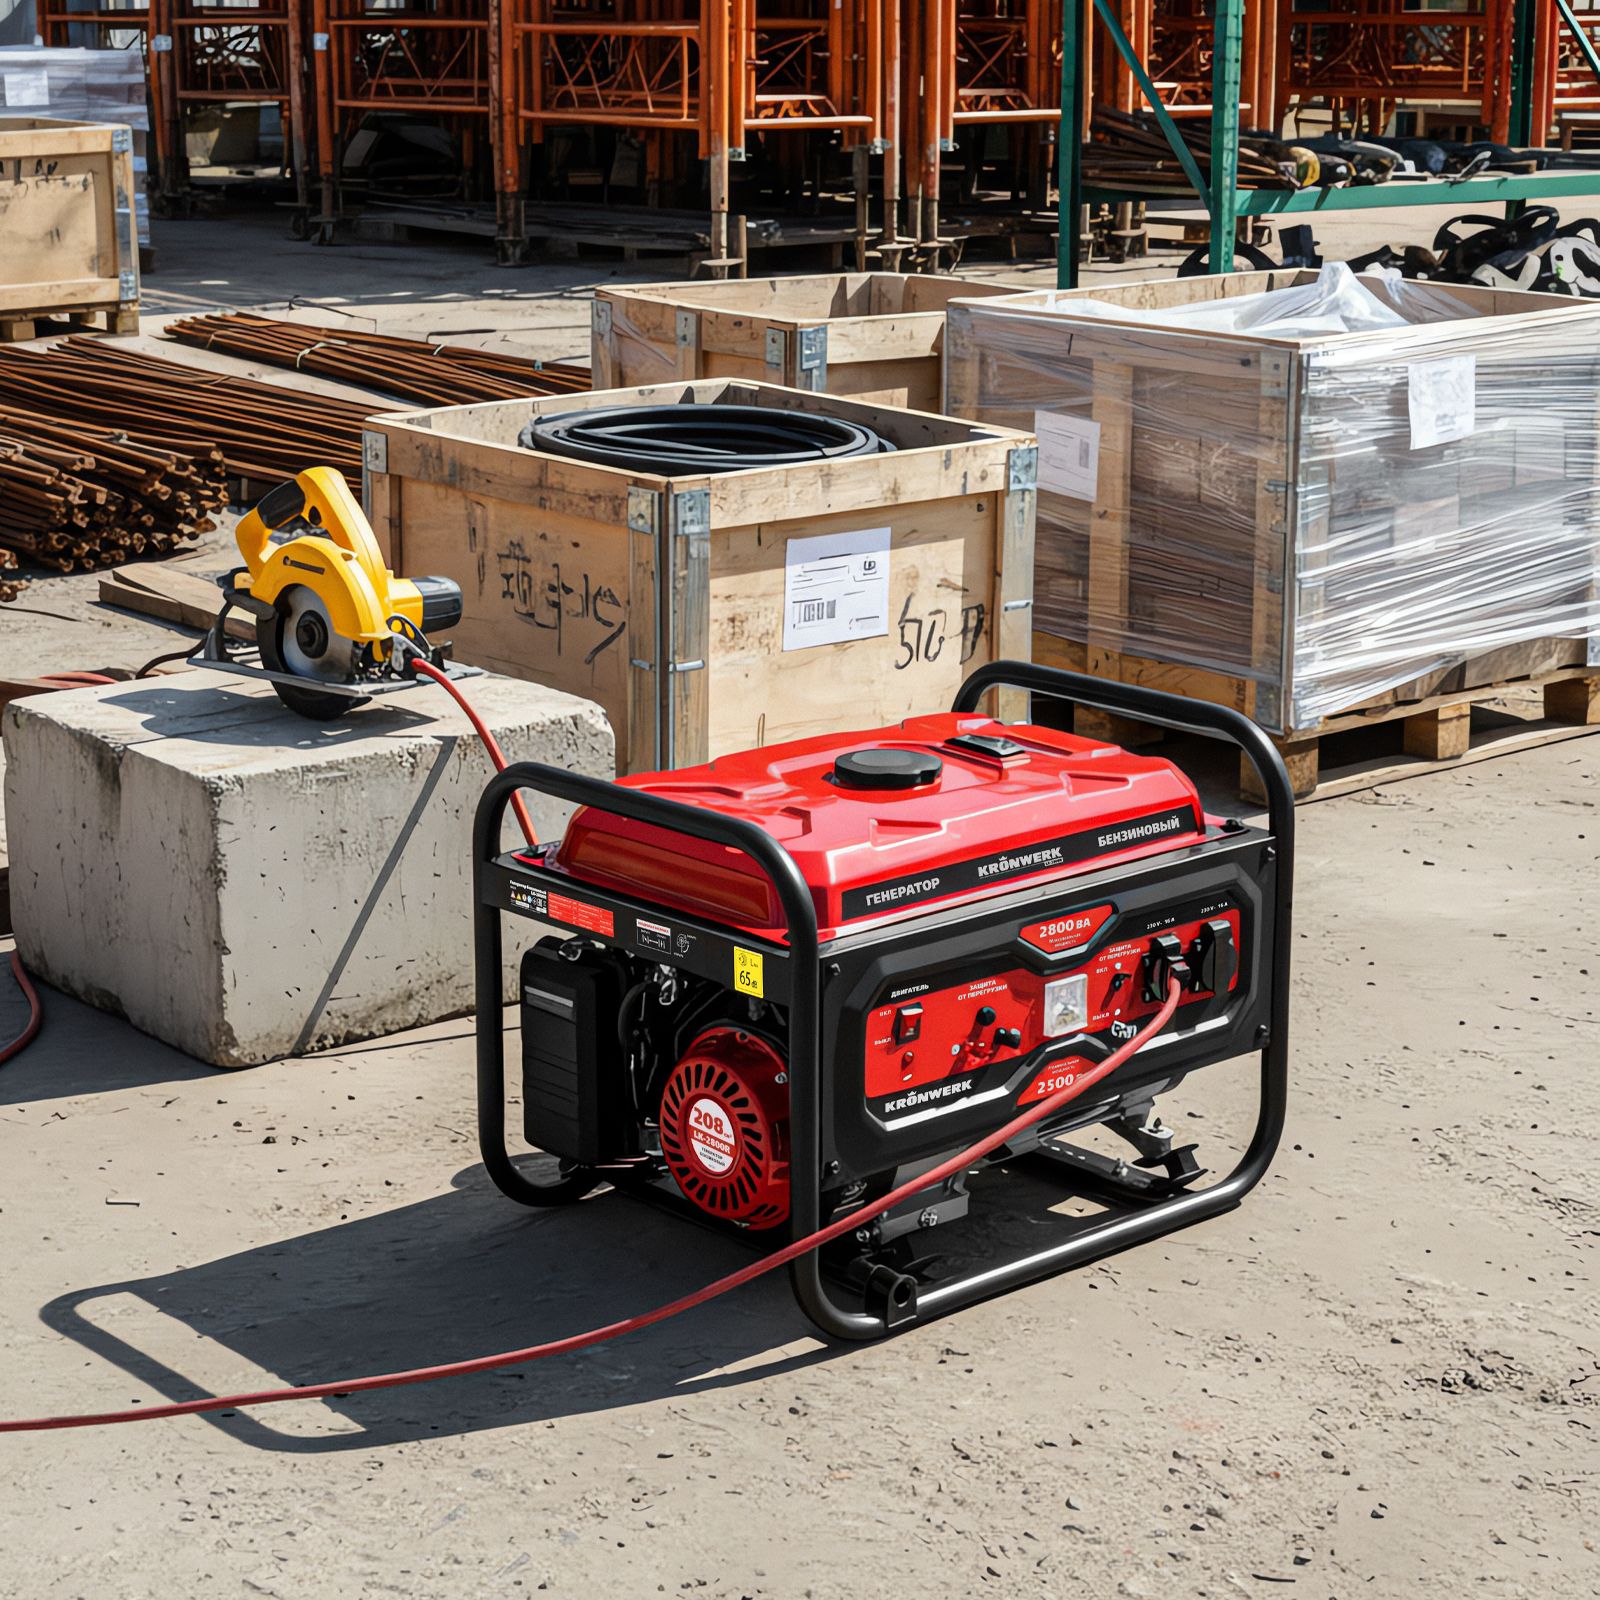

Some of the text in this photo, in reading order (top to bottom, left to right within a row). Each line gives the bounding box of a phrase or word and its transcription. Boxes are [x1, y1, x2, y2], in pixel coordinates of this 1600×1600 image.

[1097, 815, 1180, 847] БЕНЗИНОВЫЙ
[866, 877, 940, 907] ГЕНЕРАТОР
[1039, 917, 1091, 938] 2800 ВА
[1107, 947, 1141, 960] ПЕРЕГРУЗКИ
[1108, 944, 1132, 953] ЗАЩИТА
[739, 970, 751, 987] 65
[969, 979, 997, 991] ЗАЩИТА
[890, 983, 930, 998] ДВИГАТЕЛЬ
[957, 984, 1008, 1001] ОТ ПЕРЕГРУЗКИ
[1037, 1073, 1075, 1094] 2500
[693, 1106, 724, 1135] 208
[693, 1130, 731, 1153] LK-2800R
